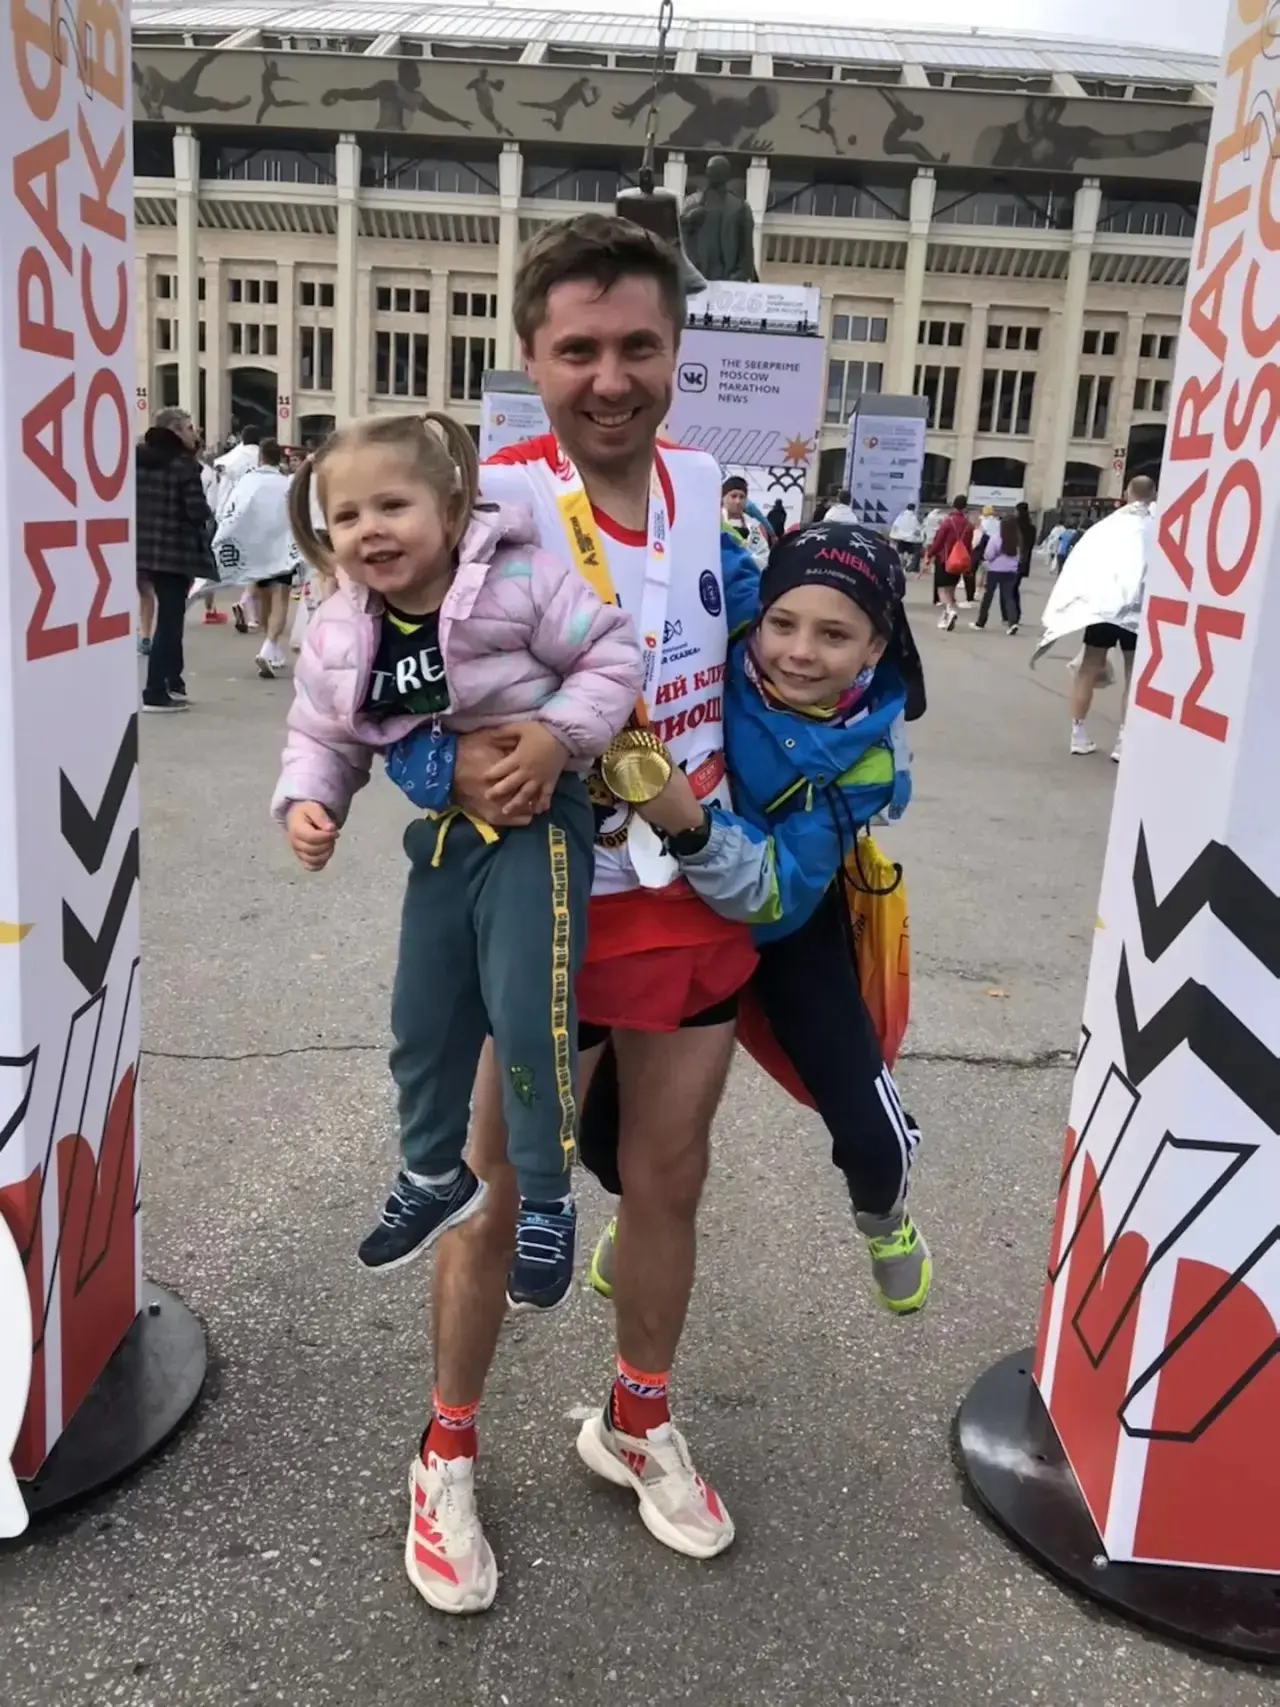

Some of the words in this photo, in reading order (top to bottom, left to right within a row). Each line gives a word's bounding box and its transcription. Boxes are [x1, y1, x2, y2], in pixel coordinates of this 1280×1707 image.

[721, 359, 741, 369] THE
[744, 360, 800, 372] SBERPRIME
[1134, 0, 1274, 720] MARATH
[720, 370, 770, 382] MOSCOW
[719, 382, 780, 394] MARATHON
[718, 394, 748, 404] NEWS
